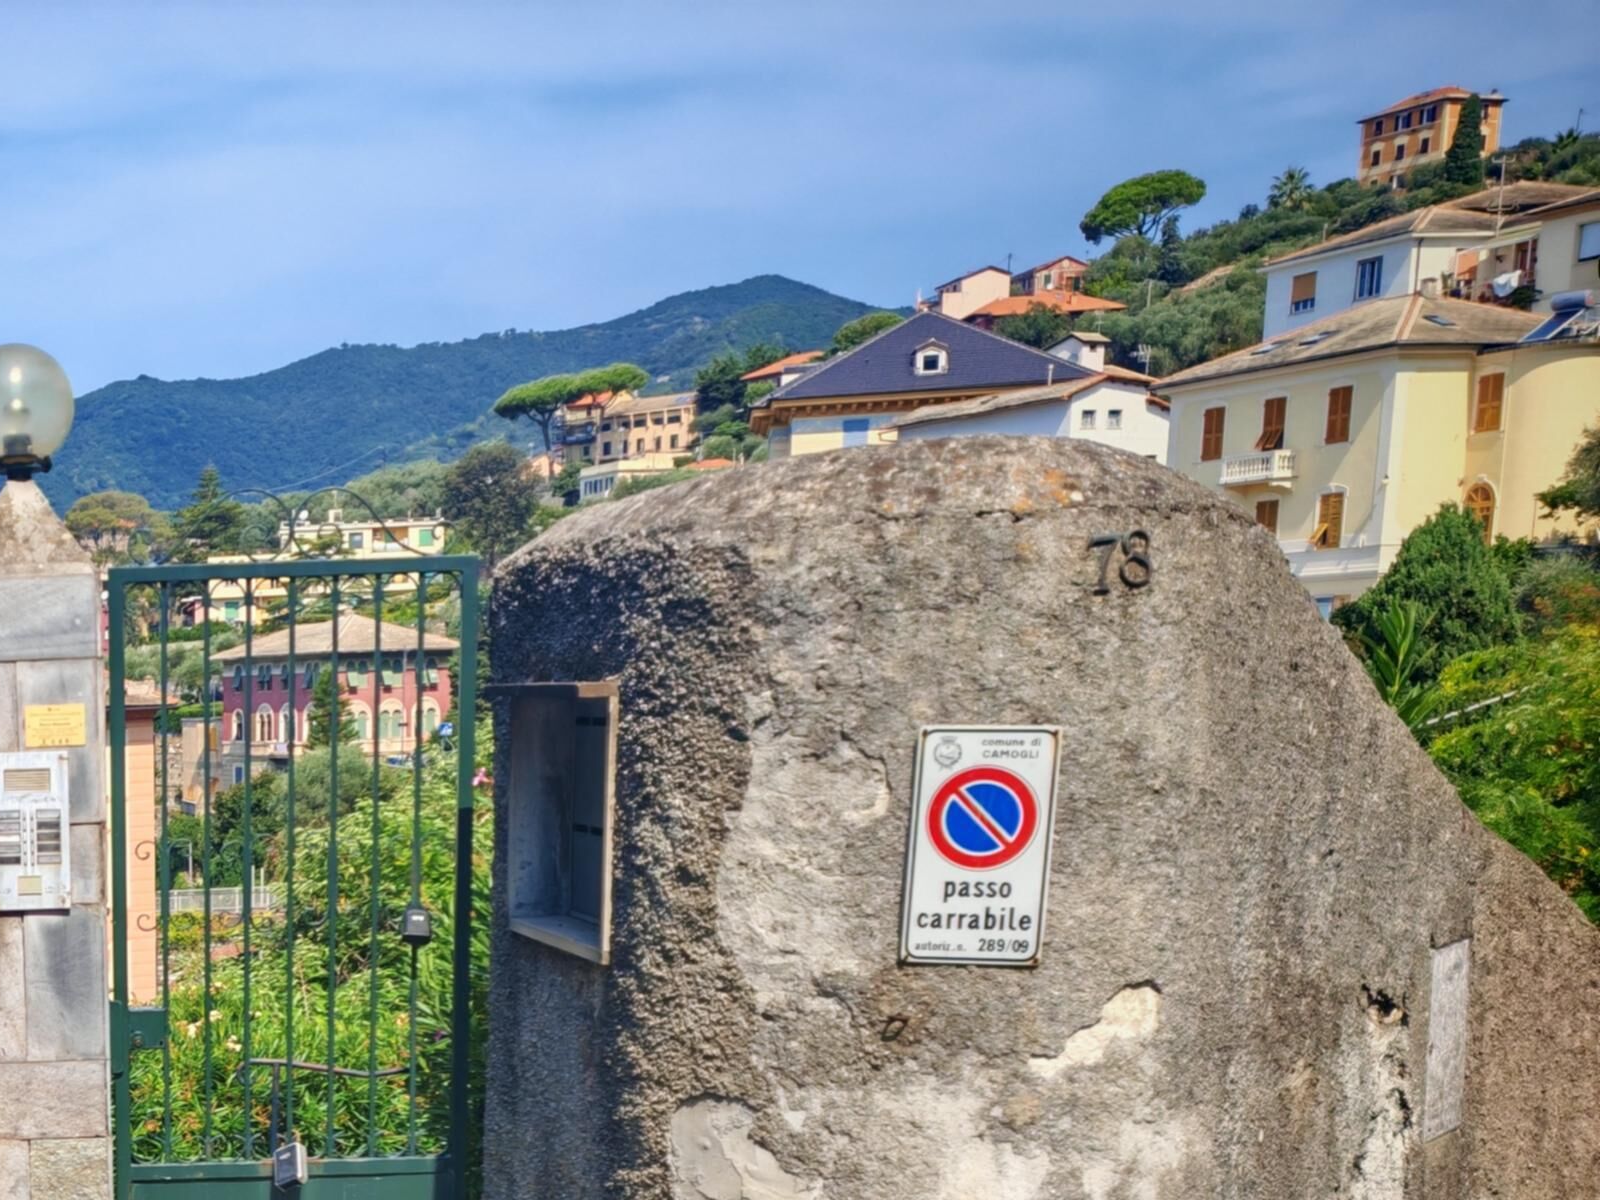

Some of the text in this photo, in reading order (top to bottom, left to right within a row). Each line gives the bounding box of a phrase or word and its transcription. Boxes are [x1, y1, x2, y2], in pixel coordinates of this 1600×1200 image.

[1087, 530, 1151, 597] 78
[982, 736, 1041, 746] comune di
[982, 750, 1040, 759] CAMOGLI
[943, 880, 1012, 902] passo
[916, 907, 1032, 932] carrabile
[978, 938, 1030, 954] 289/09
